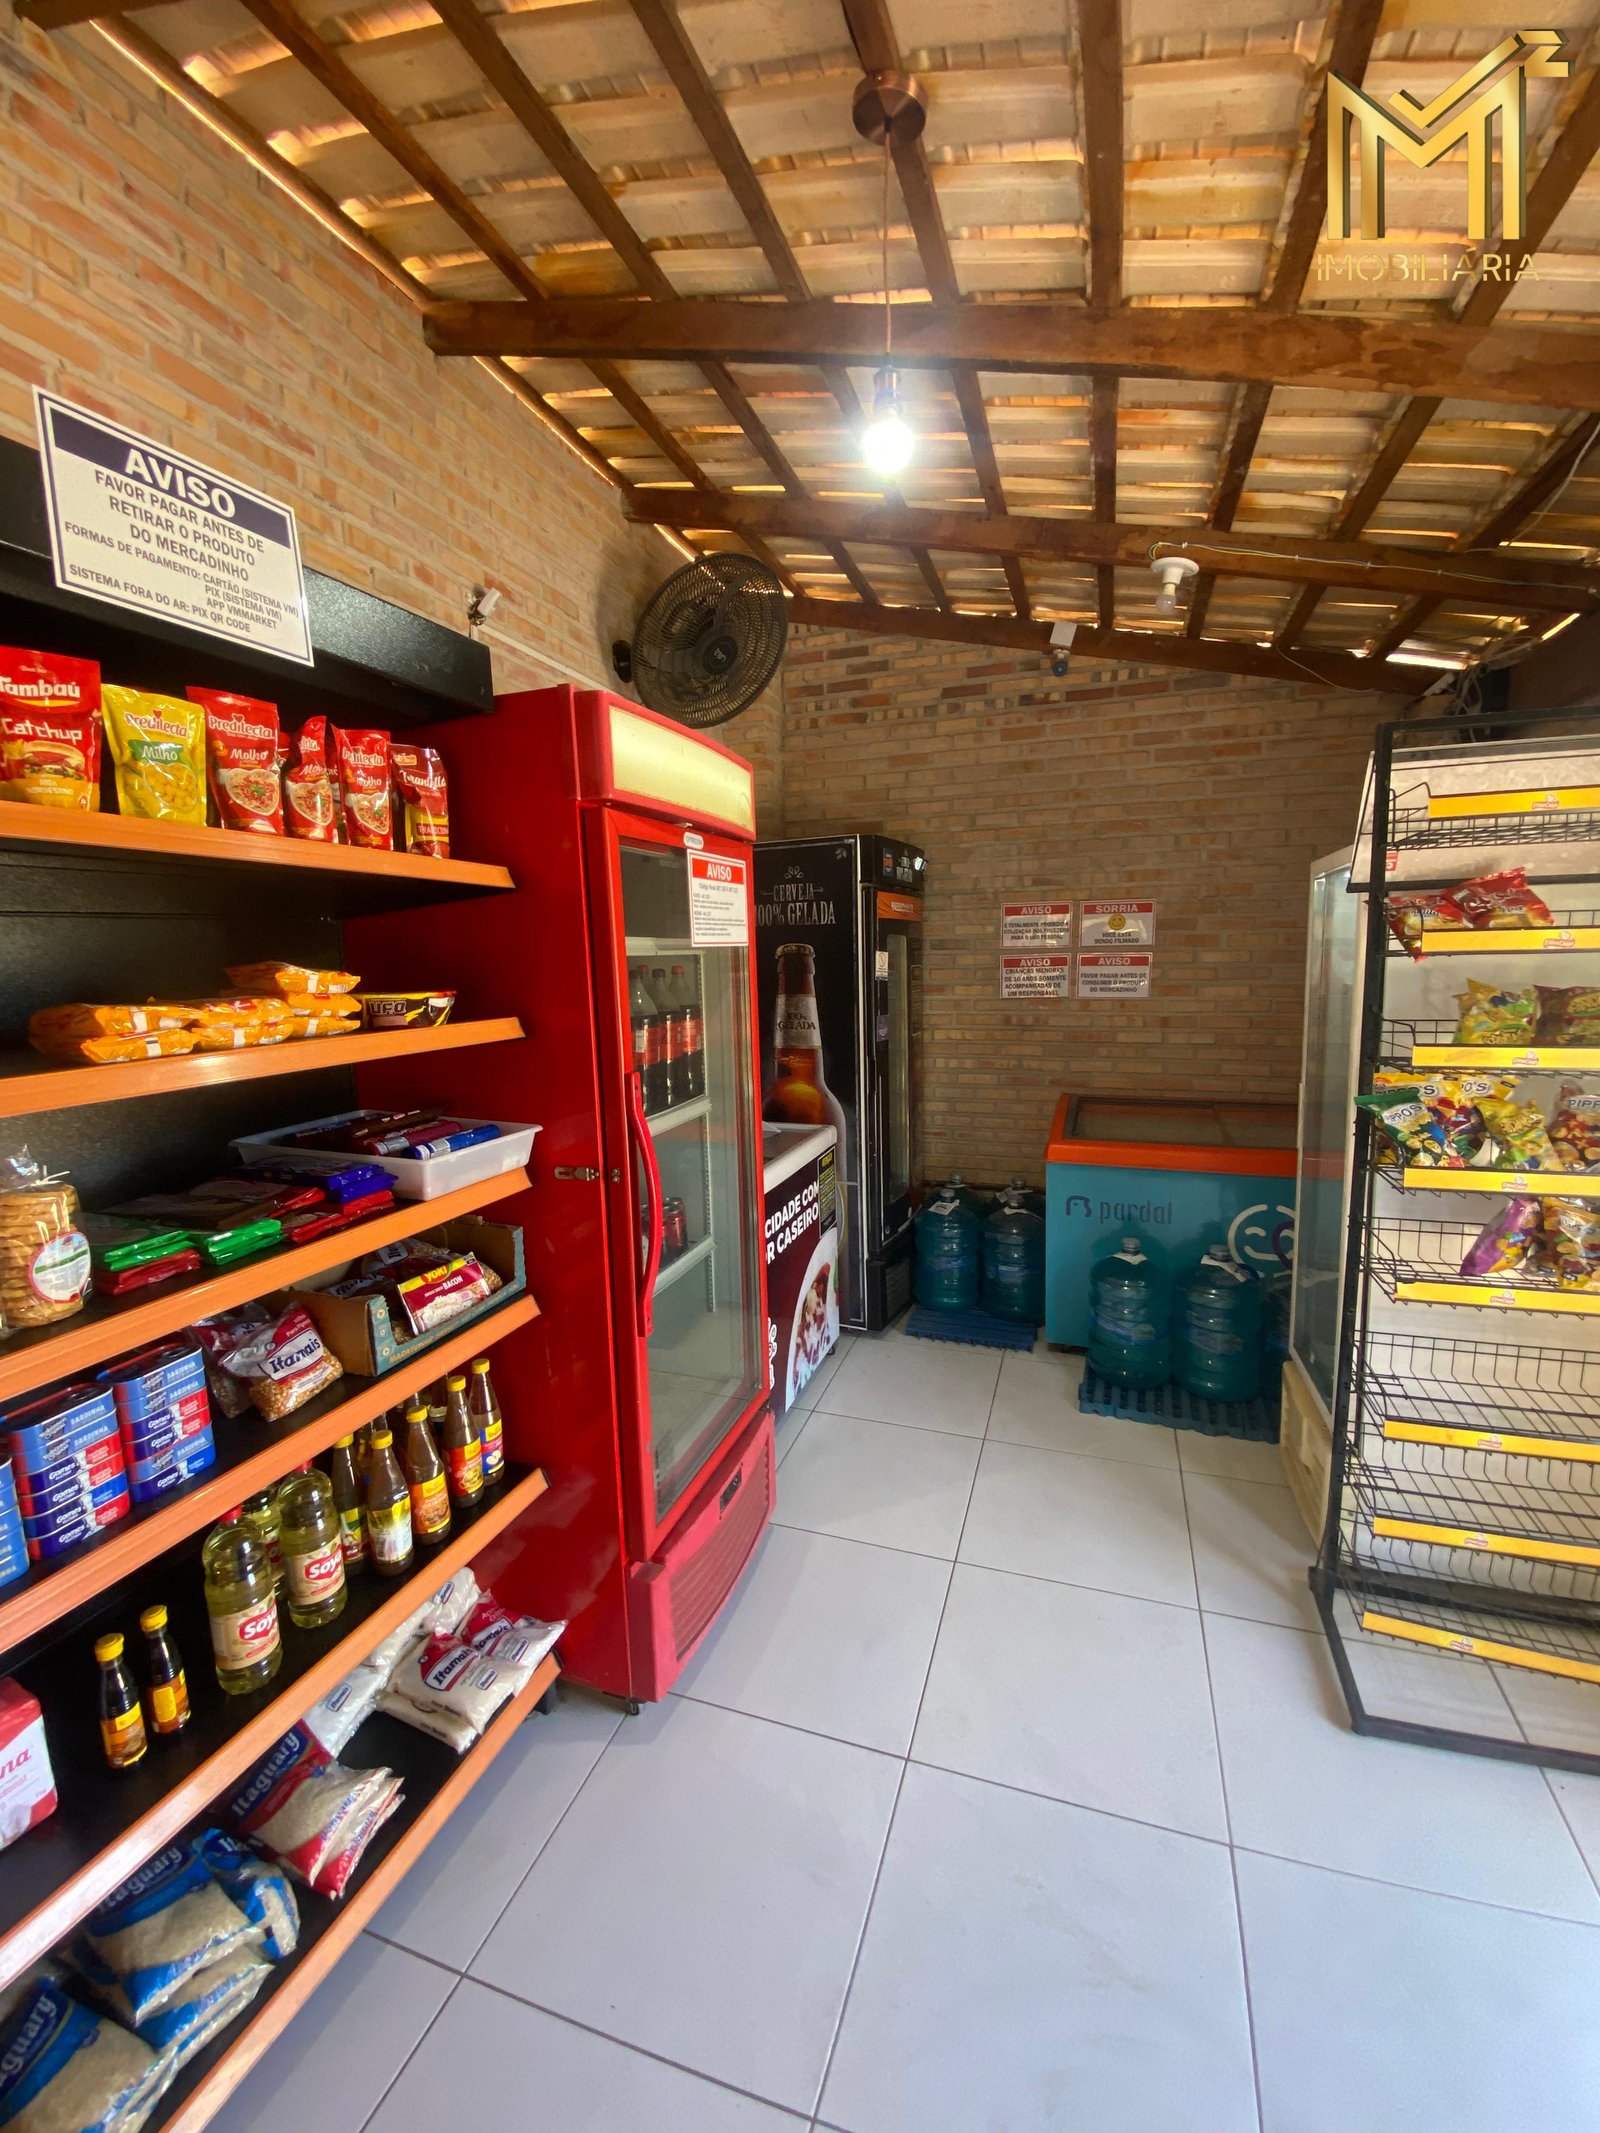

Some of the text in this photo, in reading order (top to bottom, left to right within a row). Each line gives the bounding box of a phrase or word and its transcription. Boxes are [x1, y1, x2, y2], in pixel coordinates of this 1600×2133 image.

[125, 448, 236, 519] AVISO
[95, 470, 265, 554] FAVOR PAGAR ANTES DE
[108, 495, 255, 567] RETIRAR O PRODUTO
[65, 521, 202, 580] FORMAS DE PAGAMENTO:
[130, 523, 250, 582] DO MERCADINHO
[69, 564, 251, 633] SISTEMA FORA DO AR: PIX QR CODE
[203, 571, 299, 618] CARTÃO (SISTEMA VM)
[205, 585, 283, 622] PIX (SISTEMA VM)
[206, 598, 278, 630] APP VMMARKET
[1, 718, 83, 744] Catchup
[125, 711, 189, 739] Predilecta
[208, 715, 274, 740] Predilecta
[141, 744, 179, 761] Milho
[229, 748, 269, 761] Molho
[707, 863, 732, 881] AVISO
[773, 883, 815, 901] CERVEJA
[787, 901, 836, 926] GELADA
[1021, 906, 1052, 915] AVISO
[1095, 904, 1139, 913] SORRIA
[1020, 958, 1051, 966] AVISO
[1097, 957, 1131, 965] AVISO
[1100, 1200, 1172, 1225] pardal
[777, 1202, 819, 1254] CASEIRO
[423, 1265, 448, 1282] YOKI
[442, 1275, 464, 1290] BACON
[269, 1338, 321, 1374] Itamais
[70, 1404, 106, 1426] SARDINHA
[49, 1462, 76, 1481] Gomes
[52, 1484, 79, 1502] Gomes
[56, 1506, 82, 1524] Gomes
[59, 1525, 86, 1543] Gomes
[433, 1648, 473, 1686] Itamais
[231, 1732, 300, 1817] Itaguary
